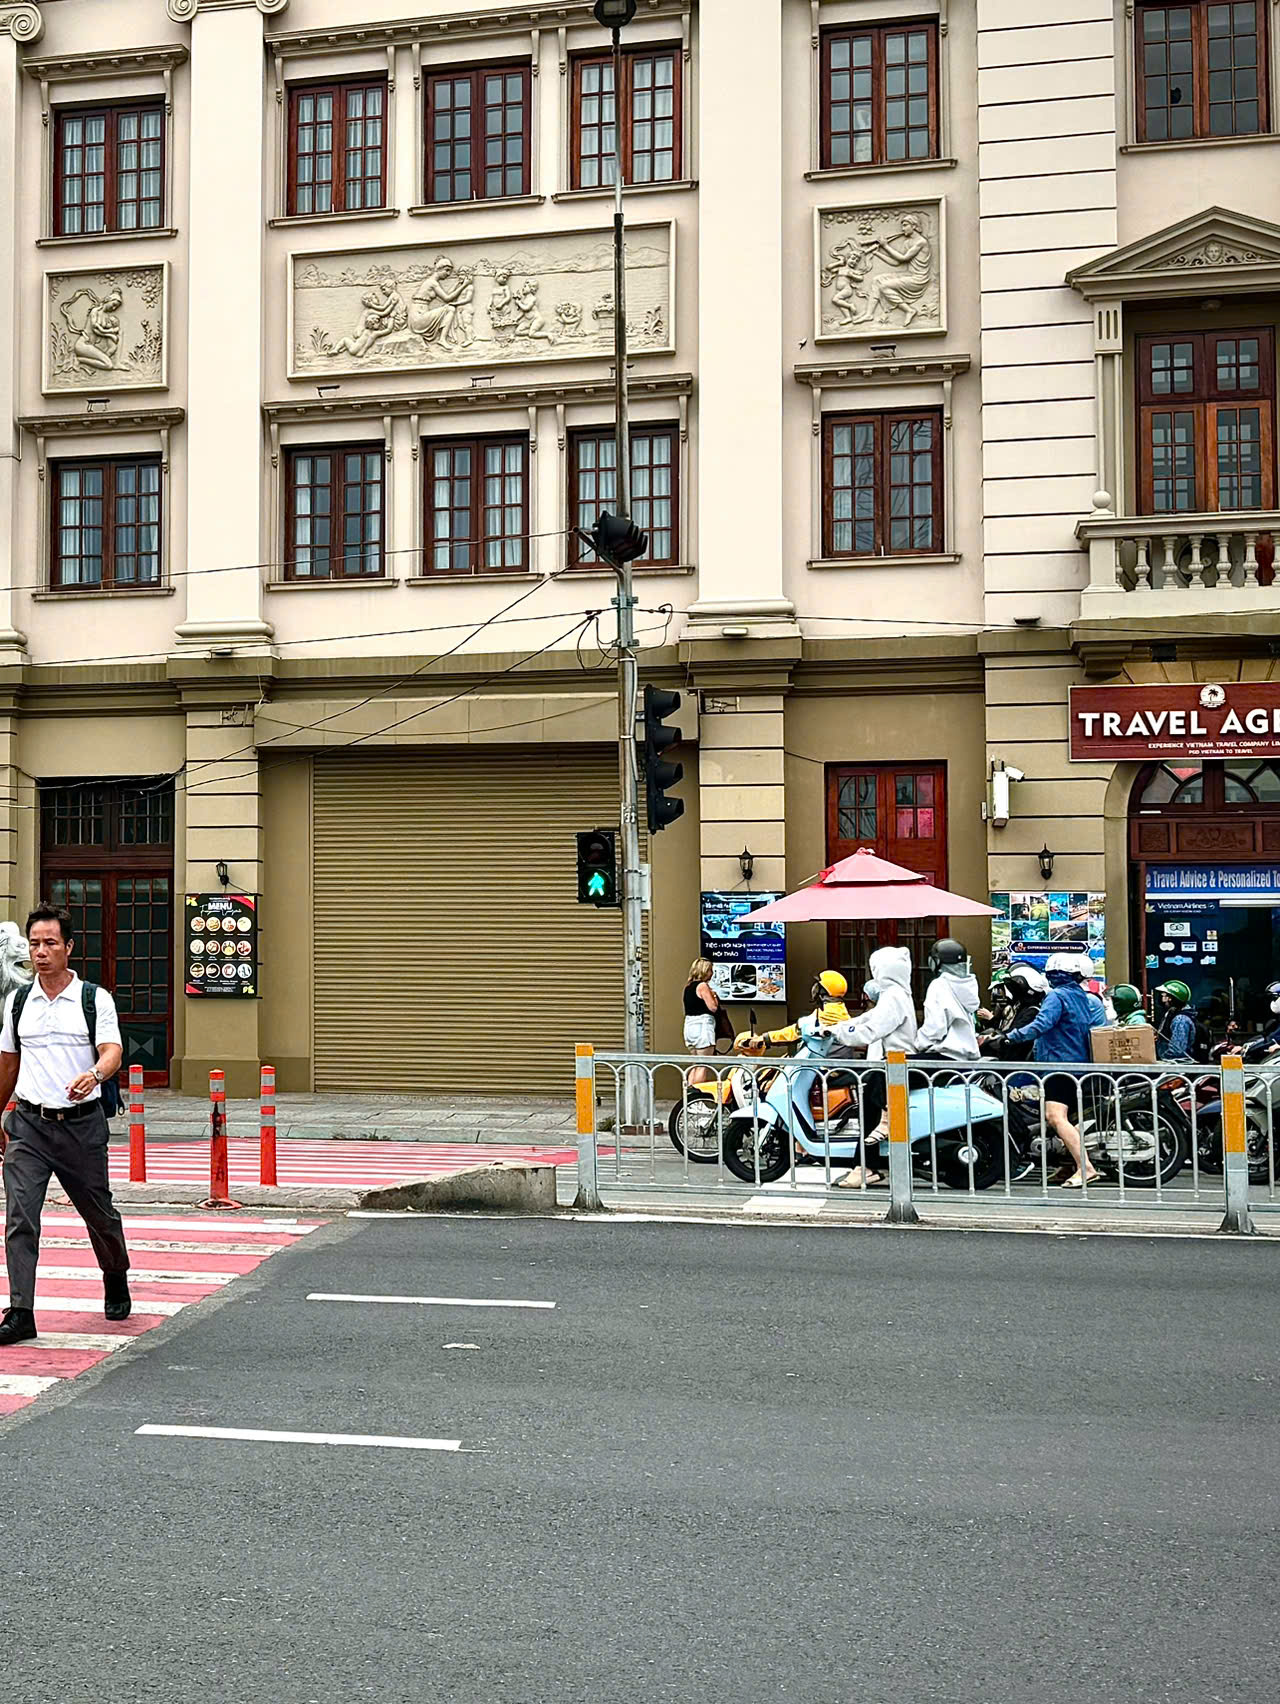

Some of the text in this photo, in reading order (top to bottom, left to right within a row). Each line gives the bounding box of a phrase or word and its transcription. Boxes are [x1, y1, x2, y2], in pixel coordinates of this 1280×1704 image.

[1078, 710, 1207, 737] TRAVEL
[1153, 870, 1177, 888] Travel
[1180, 870, 1207, 888] Advice
[1209, 870, 1216, 888] &
[1218, 870, 1271, 888] Personalized
[207, 902, 233, 911] MENU
